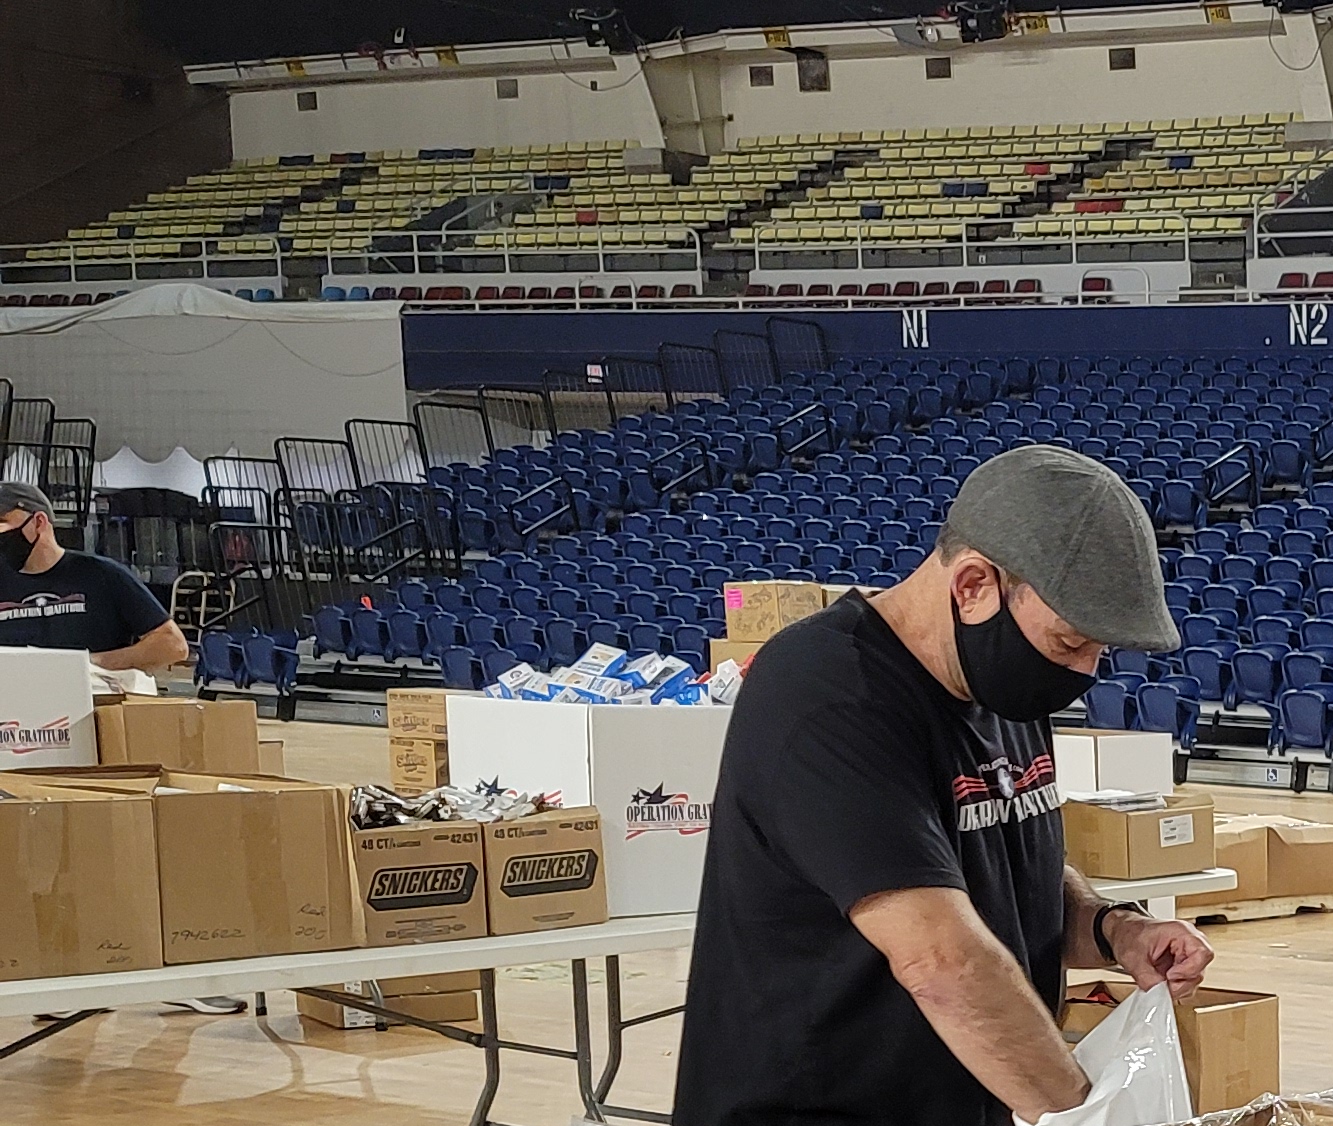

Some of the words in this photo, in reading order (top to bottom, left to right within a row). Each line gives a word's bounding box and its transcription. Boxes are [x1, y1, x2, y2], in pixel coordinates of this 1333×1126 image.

[902, 308, 929, 349] N1
[1289, 303, 1329, 346] N2
[44, 601, 87, 616] GRATITUDE
[18, 728, 71, 744] GRATITUDE
[626, 802, 685, 822] OPERATION
[374, 867, 465, 897] SNICKERS
[506, 853, 587, 884] SNICKERS
